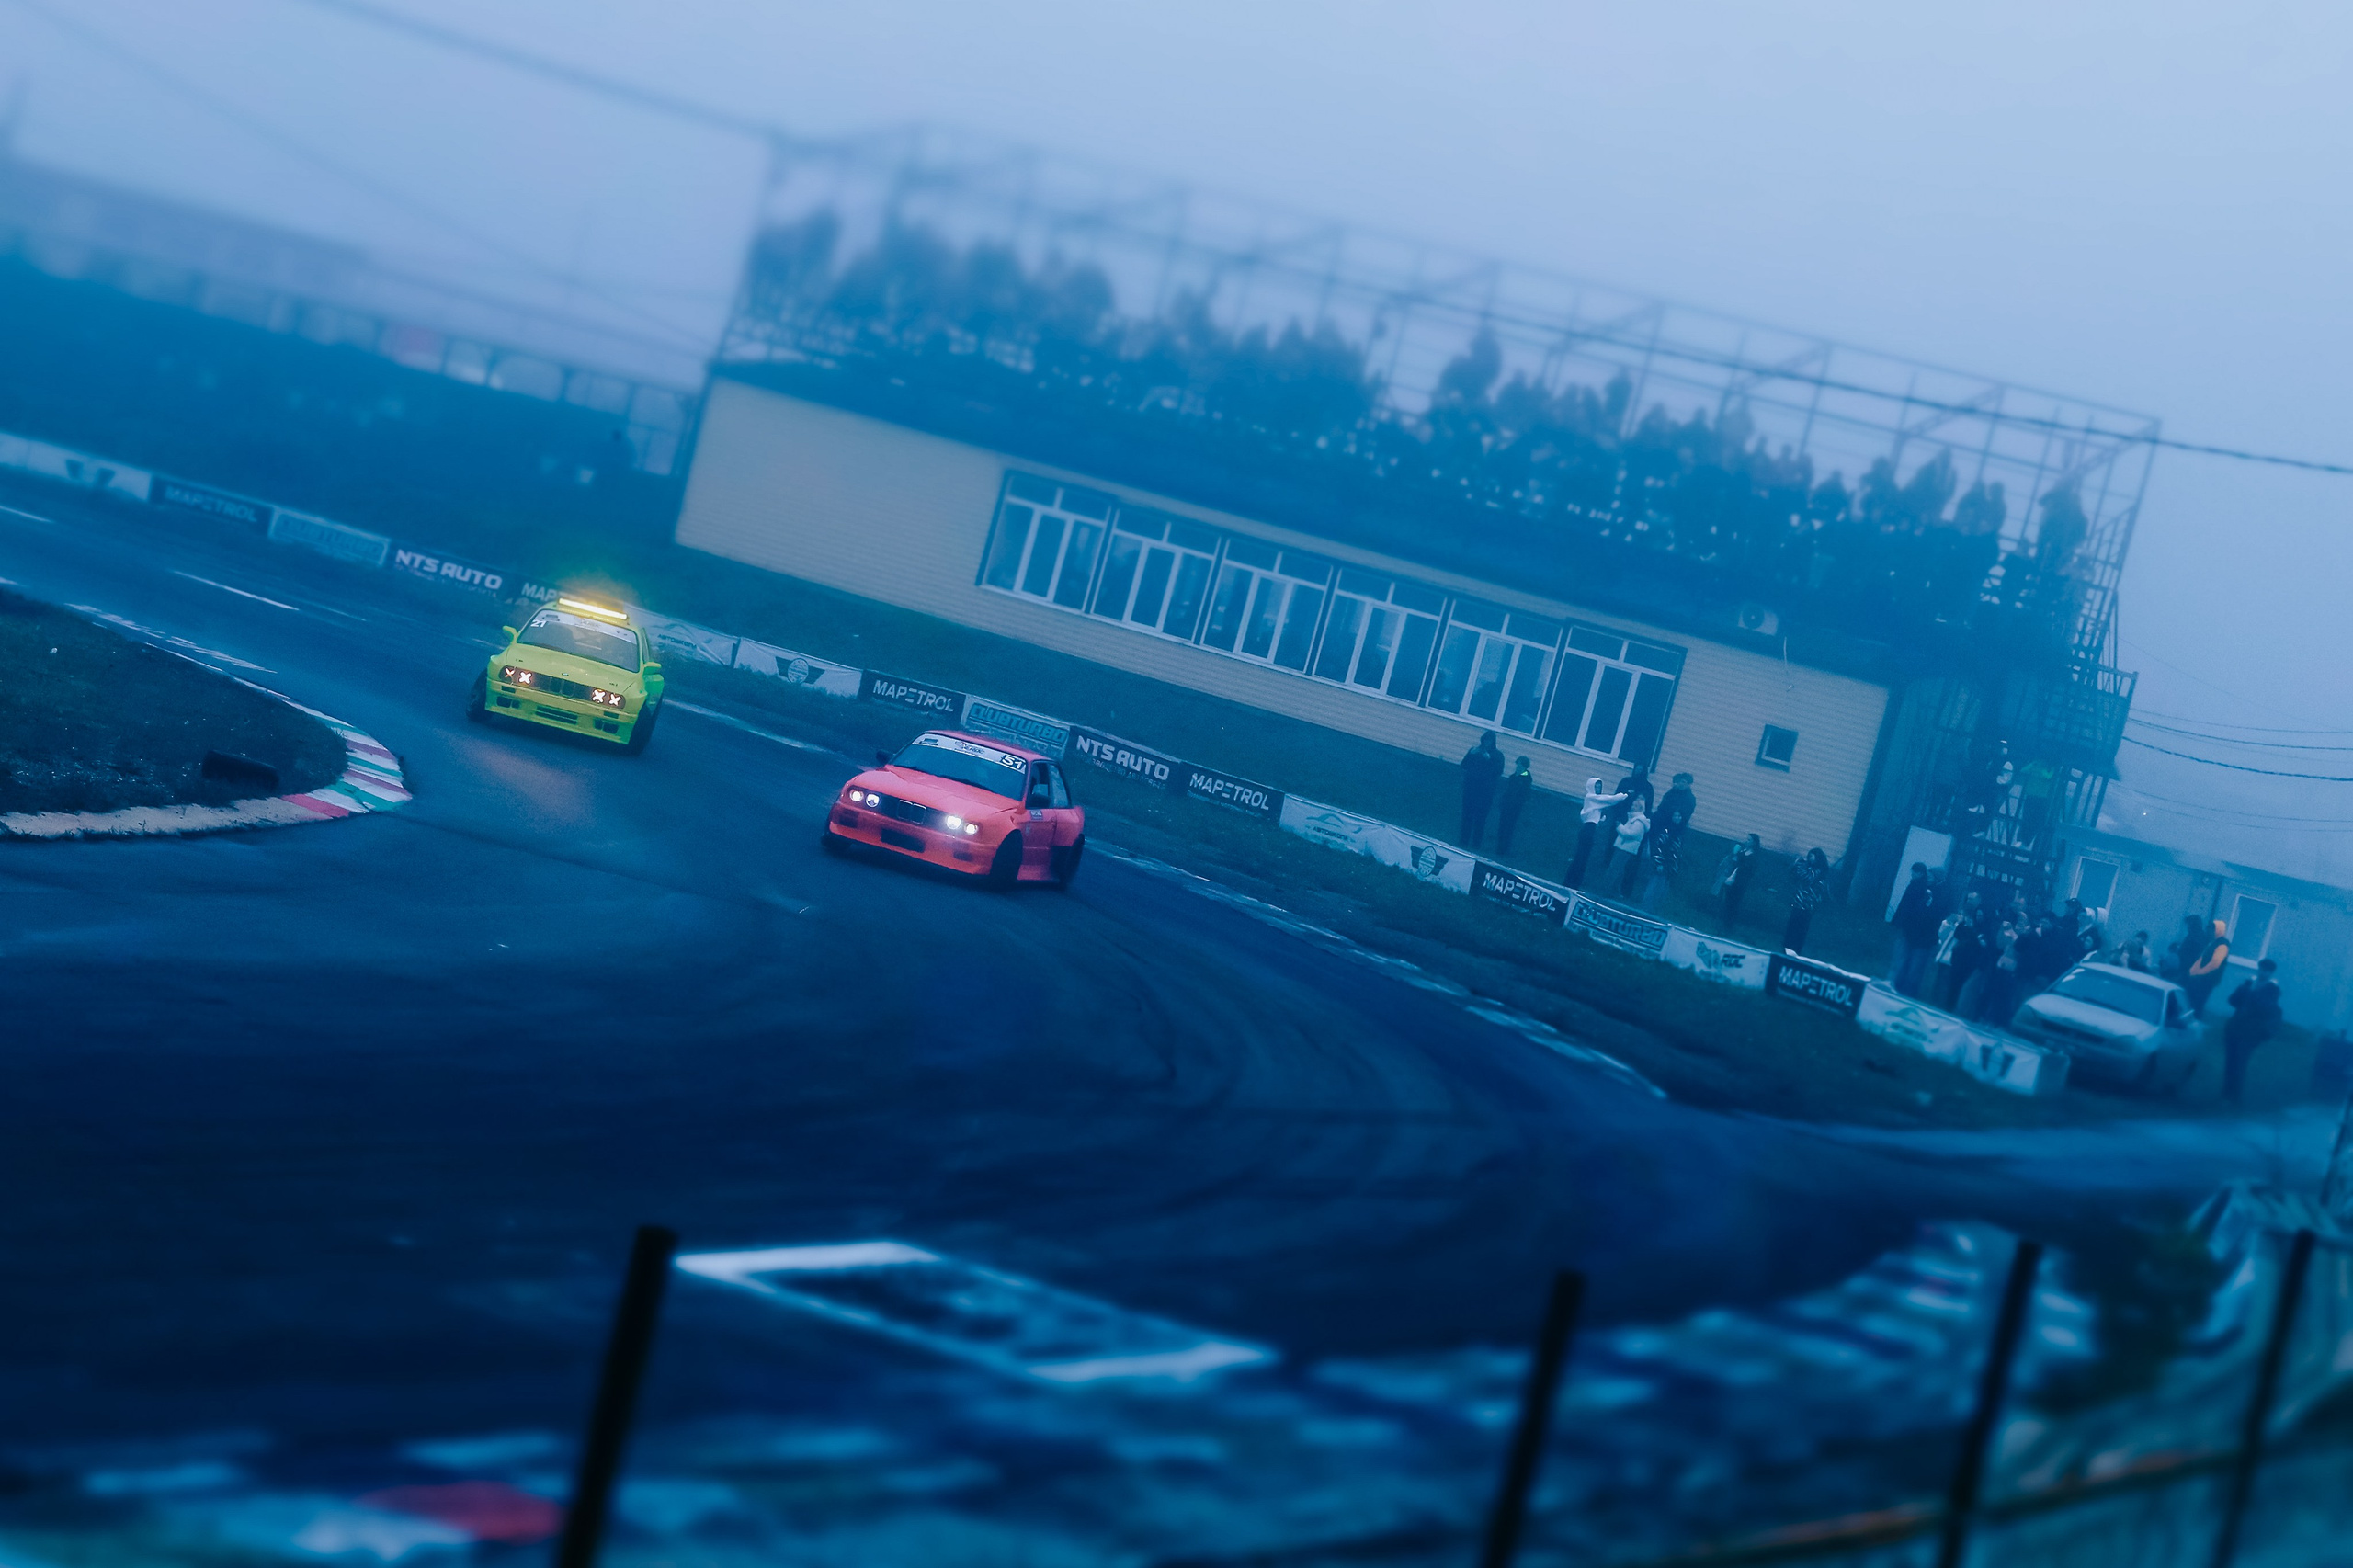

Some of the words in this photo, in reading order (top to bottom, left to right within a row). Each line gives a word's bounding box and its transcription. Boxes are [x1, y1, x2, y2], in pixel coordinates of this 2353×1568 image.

[165, 485, 257, 523] MAPETROL
[395, 549, 439, 573] NTS
[440, 562, 503, 590] AUTO
[530, 619, 547, 628] 21
[873, 679, 954, 712] MAPETROL
[1002, 756, 1022, 769] 51
[1076, 735, 1115, 761] NTS
[1116, 749, 1170, 781] AUTO
[1189, 773, 1269, 811] MAPETROL
[1483, 872, 1556, 912] MAPETROL
[1779, 965, 1854, 1006] MAPETROL
